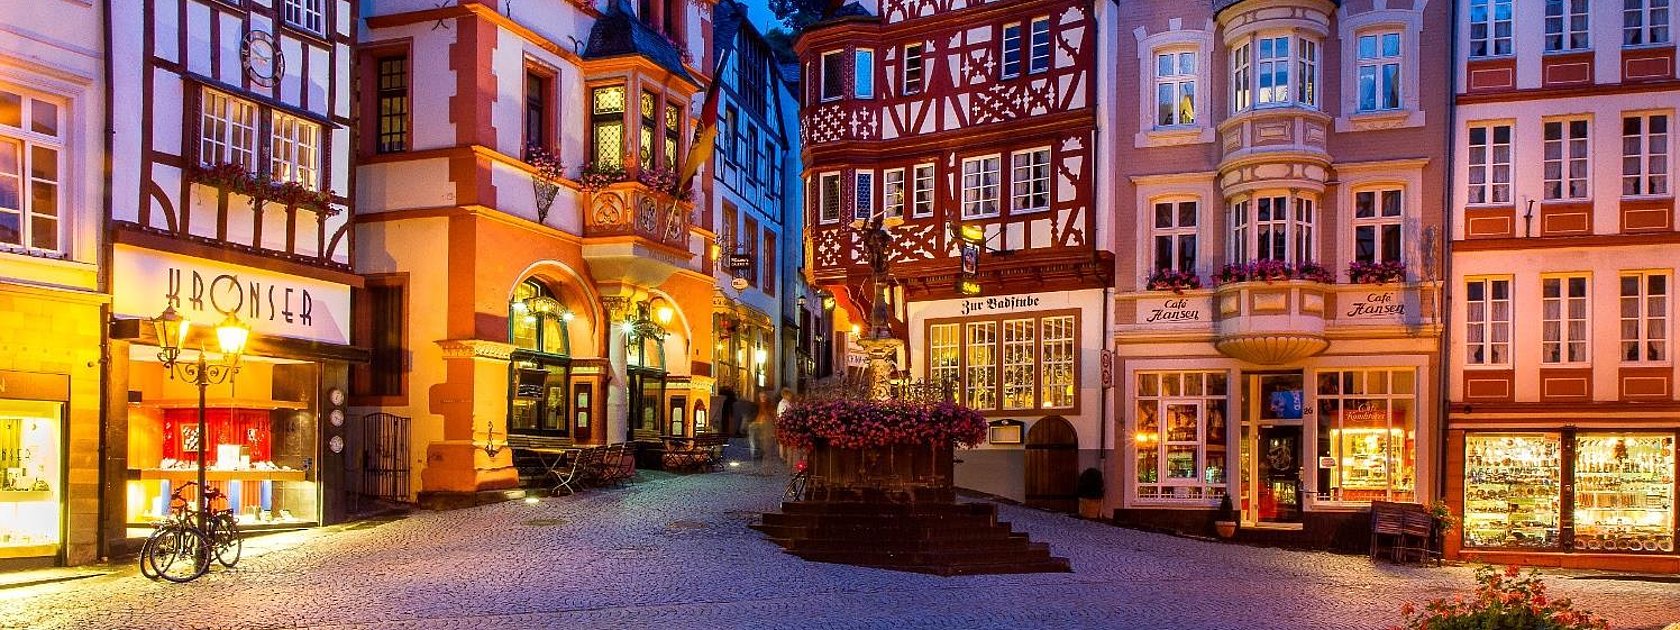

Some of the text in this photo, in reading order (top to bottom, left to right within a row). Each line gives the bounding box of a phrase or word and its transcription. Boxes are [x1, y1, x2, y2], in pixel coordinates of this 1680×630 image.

[165, 267, 312, 327] KRONSER
[1164, 298, 1189, 310] Café
[1367, 292, 1394, 304] Café
[961, 300, 983, 315] Zur
[1347, 302, 1405, 317] Hansen
[1146, 309, 1200, 322] Hansen
